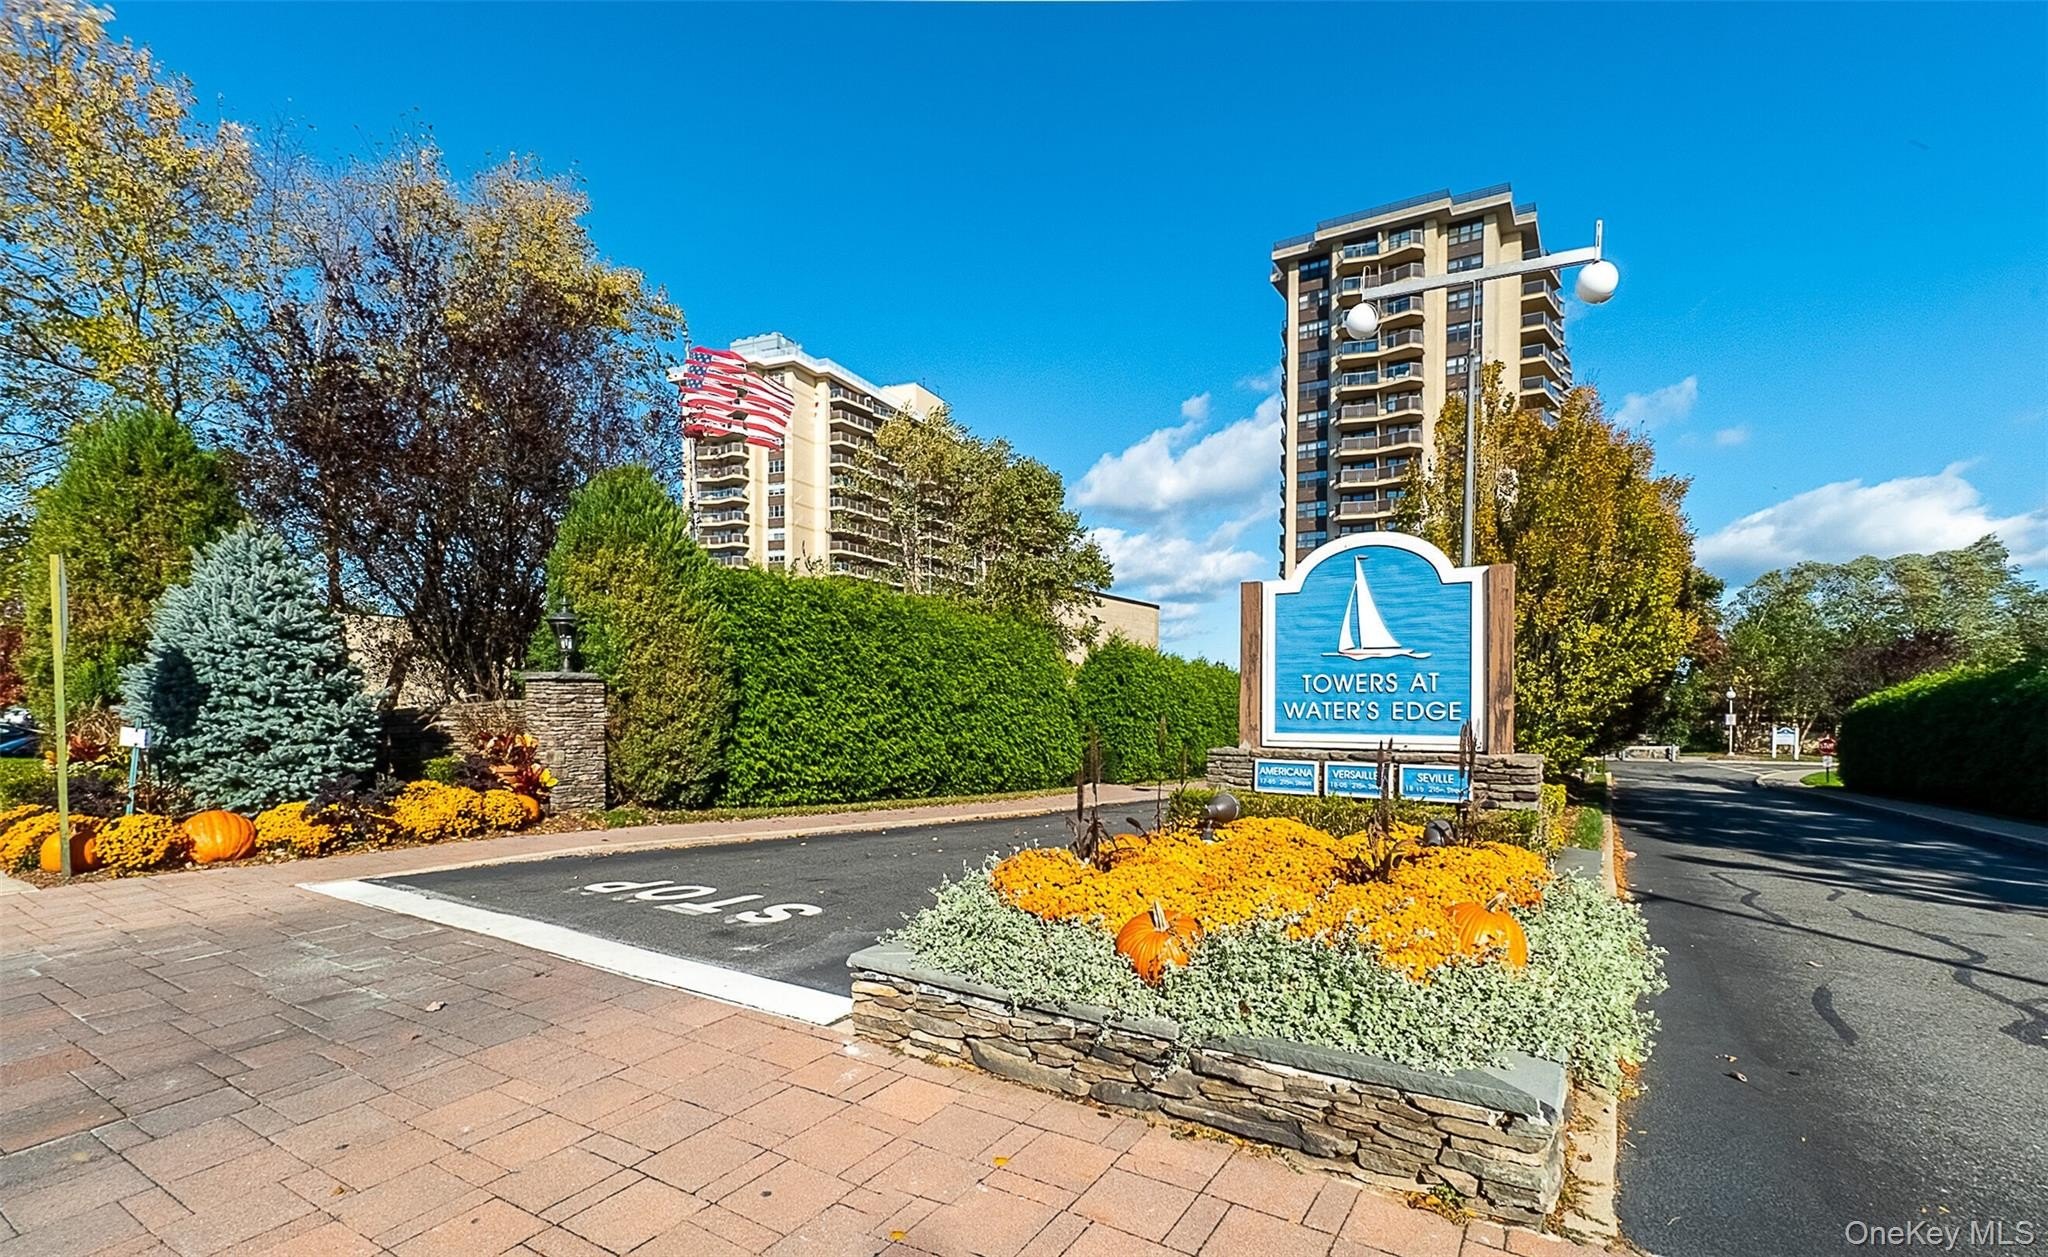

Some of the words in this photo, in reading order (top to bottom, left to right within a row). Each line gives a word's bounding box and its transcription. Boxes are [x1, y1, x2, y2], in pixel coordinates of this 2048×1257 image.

[1302, 673, 1398, 693] TOWERS
[1409, 672, 1440, 692] AT
[1283, 700, 1380, 720] WATER'S
[1392, 701, 1462, 721] EDGE
[1259, 766, 1313, 778] AMERICANA
[1332, 769, 1378, 780] VERSAILLE
[1417, 773, 1455, 784] SEVILLE
[584, 880, 823, 923] STOP
